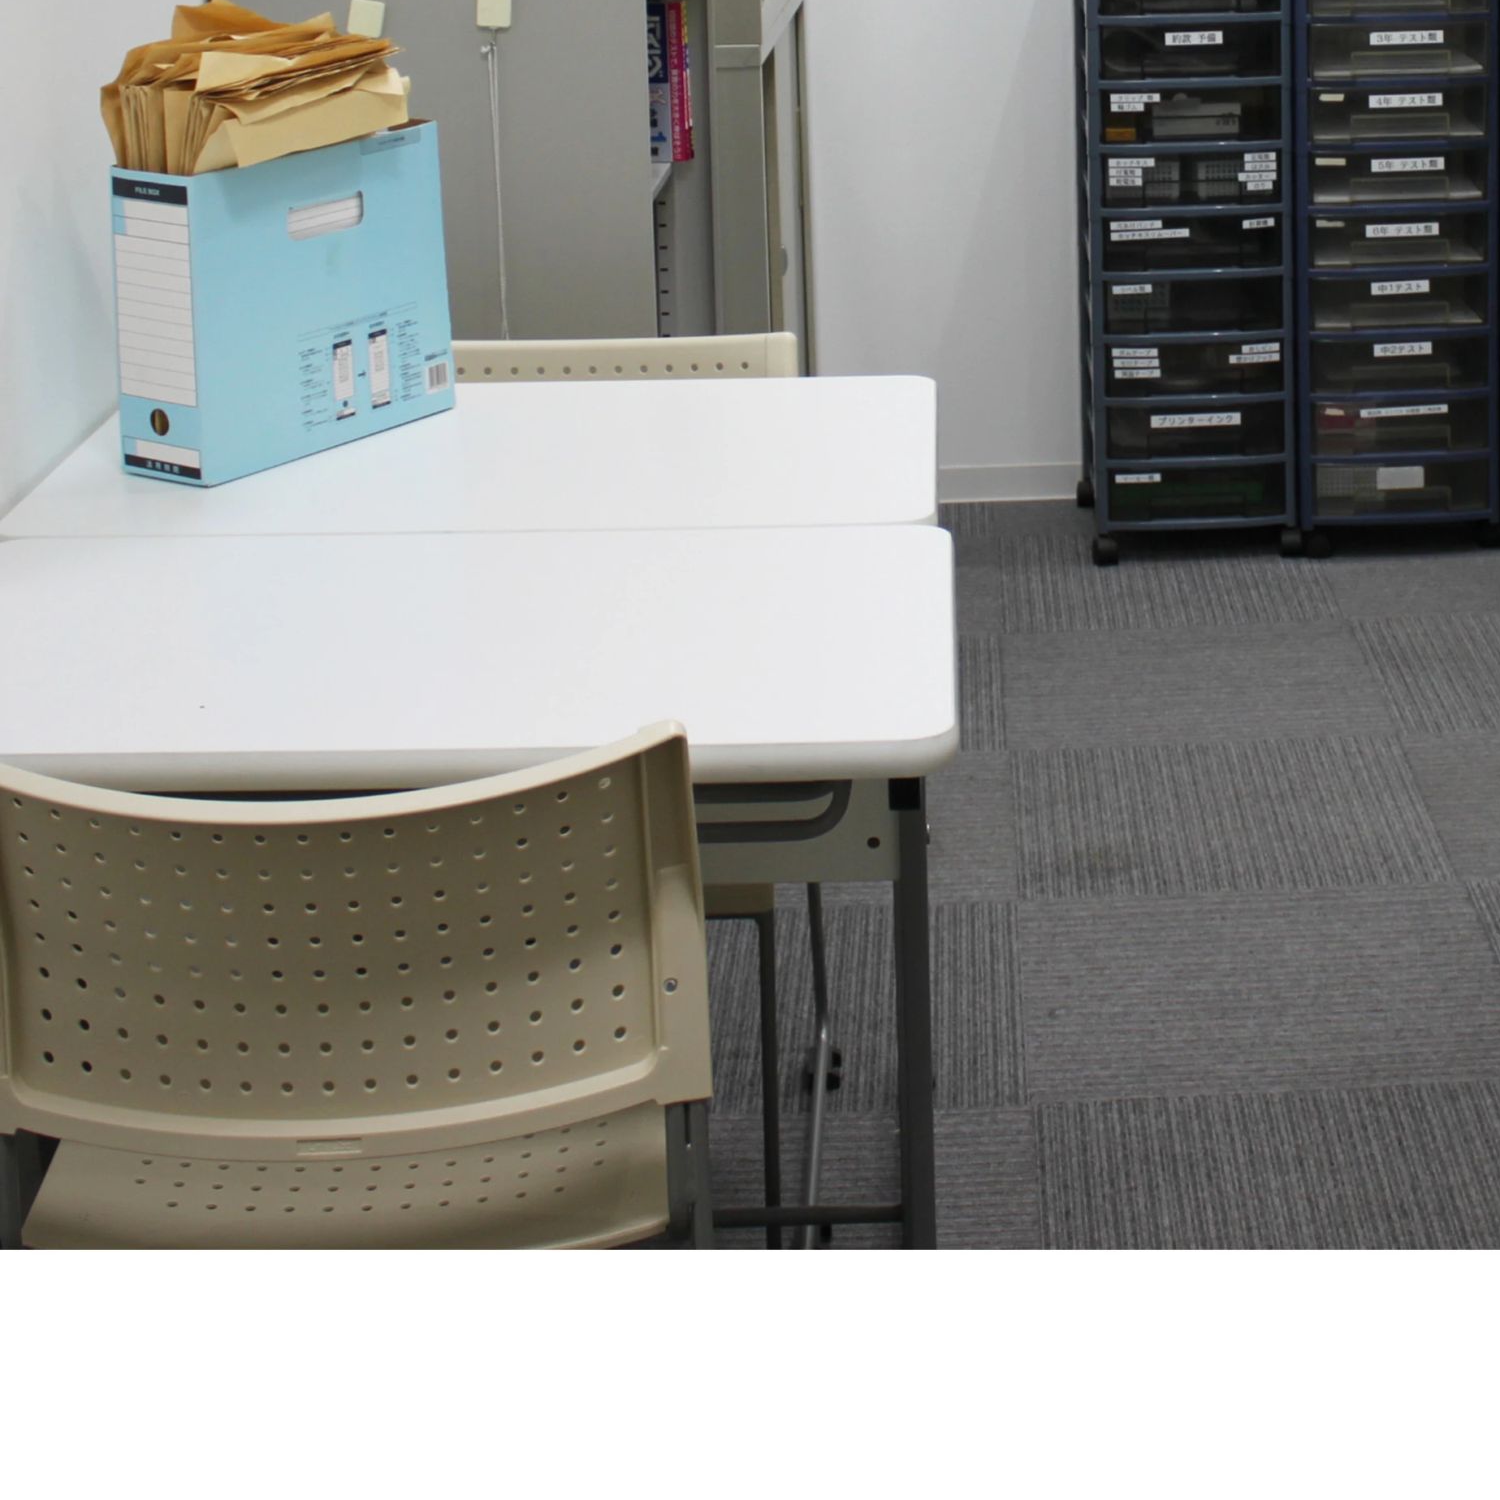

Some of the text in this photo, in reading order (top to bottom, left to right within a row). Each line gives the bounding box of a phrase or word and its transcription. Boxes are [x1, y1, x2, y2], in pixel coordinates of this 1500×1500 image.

[1376, 33, 1437, 43] 3年 テスト類
[1376, 96, 1392, 106] 4年
[1378, 159, 1438, 170] 5年 テスト類
[1395, 225, 1433, 234] テスト類
[1159, 415, 1233, 426] プリンターインク
